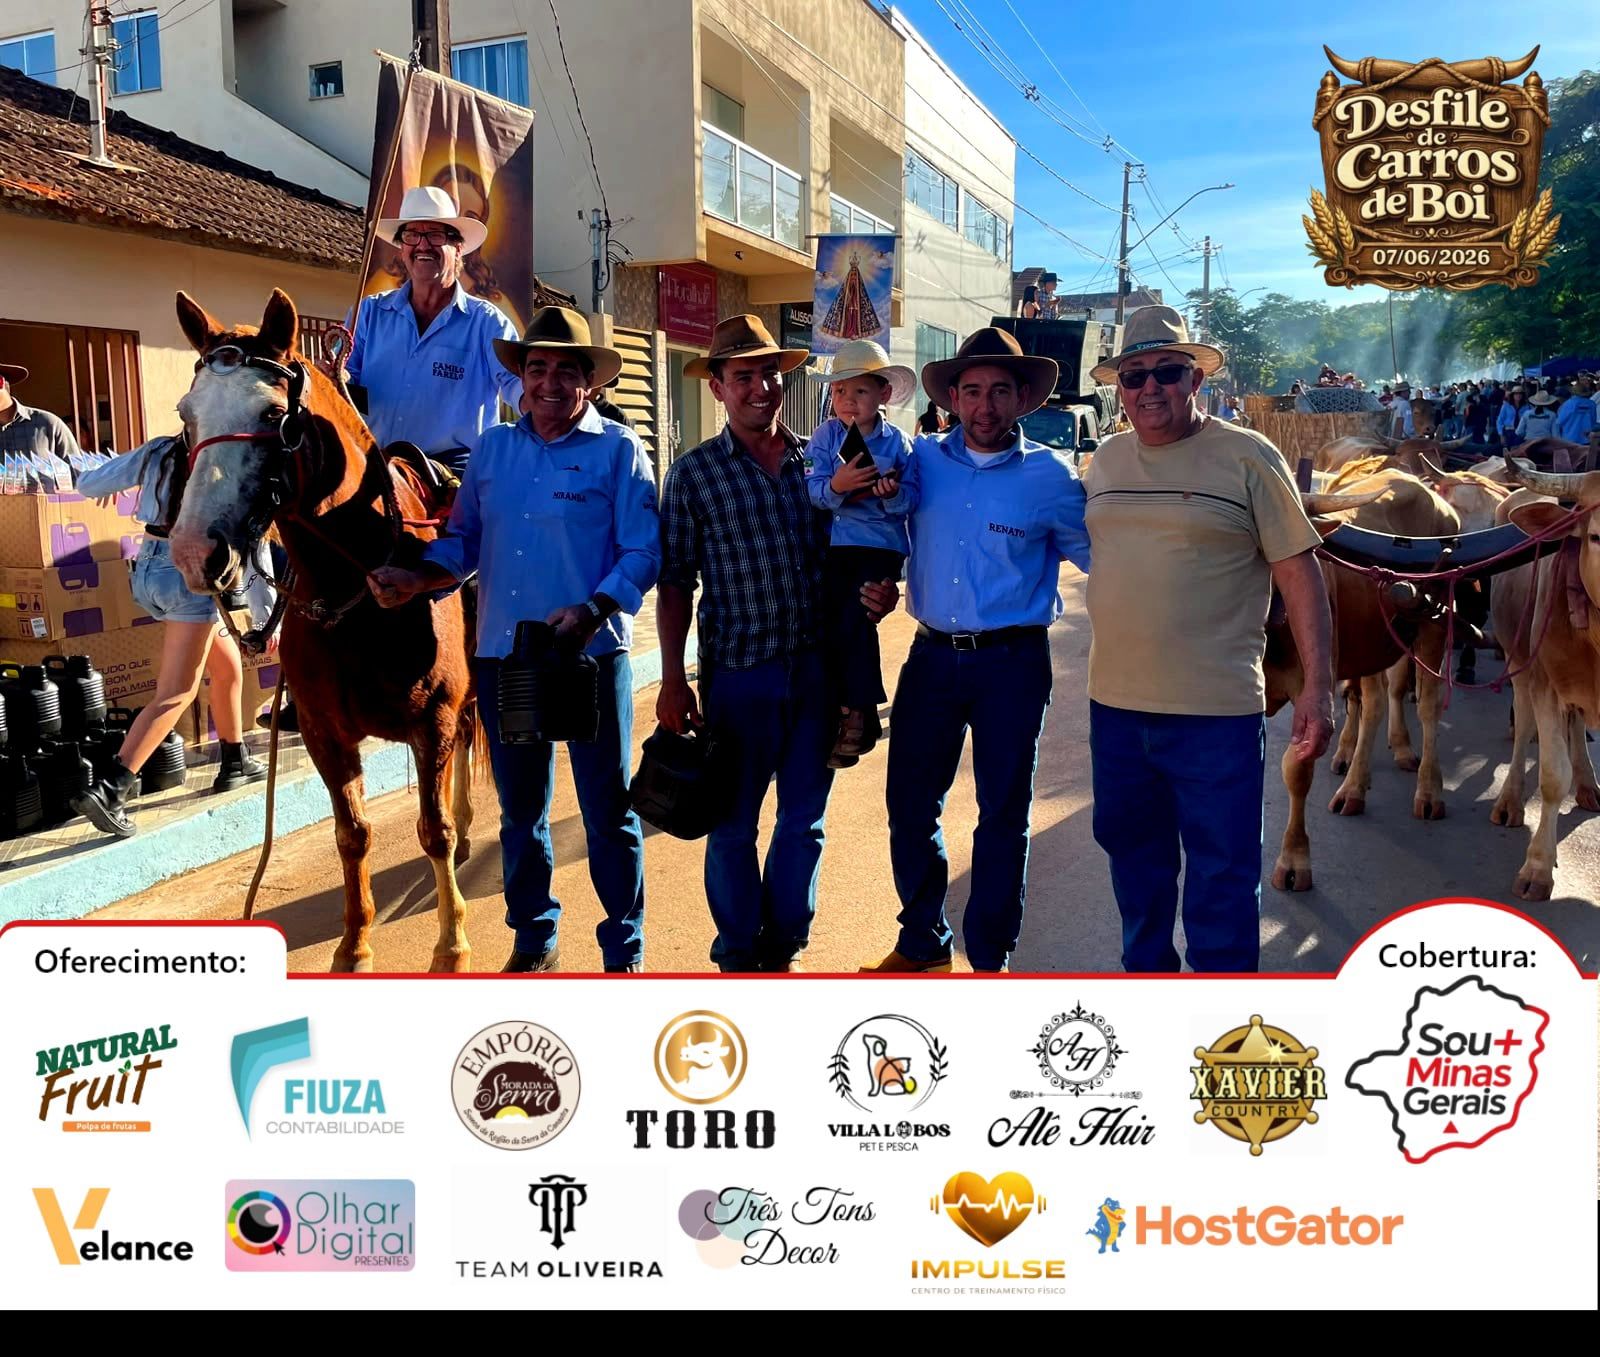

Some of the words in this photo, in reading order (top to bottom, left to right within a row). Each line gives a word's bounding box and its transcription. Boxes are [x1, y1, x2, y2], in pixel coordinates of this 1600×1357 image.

[790, 309, 813, 324] ALISSO
[433, 361, 465, 373] CAMILO
[989, 522, 1025, 538] RENATO
[129, 658, 151, 669] QUE
[105, 673, 131, 686] BOM
[104, 686, 127, 697] URA
[130, 678, 157, 692] MAIS
